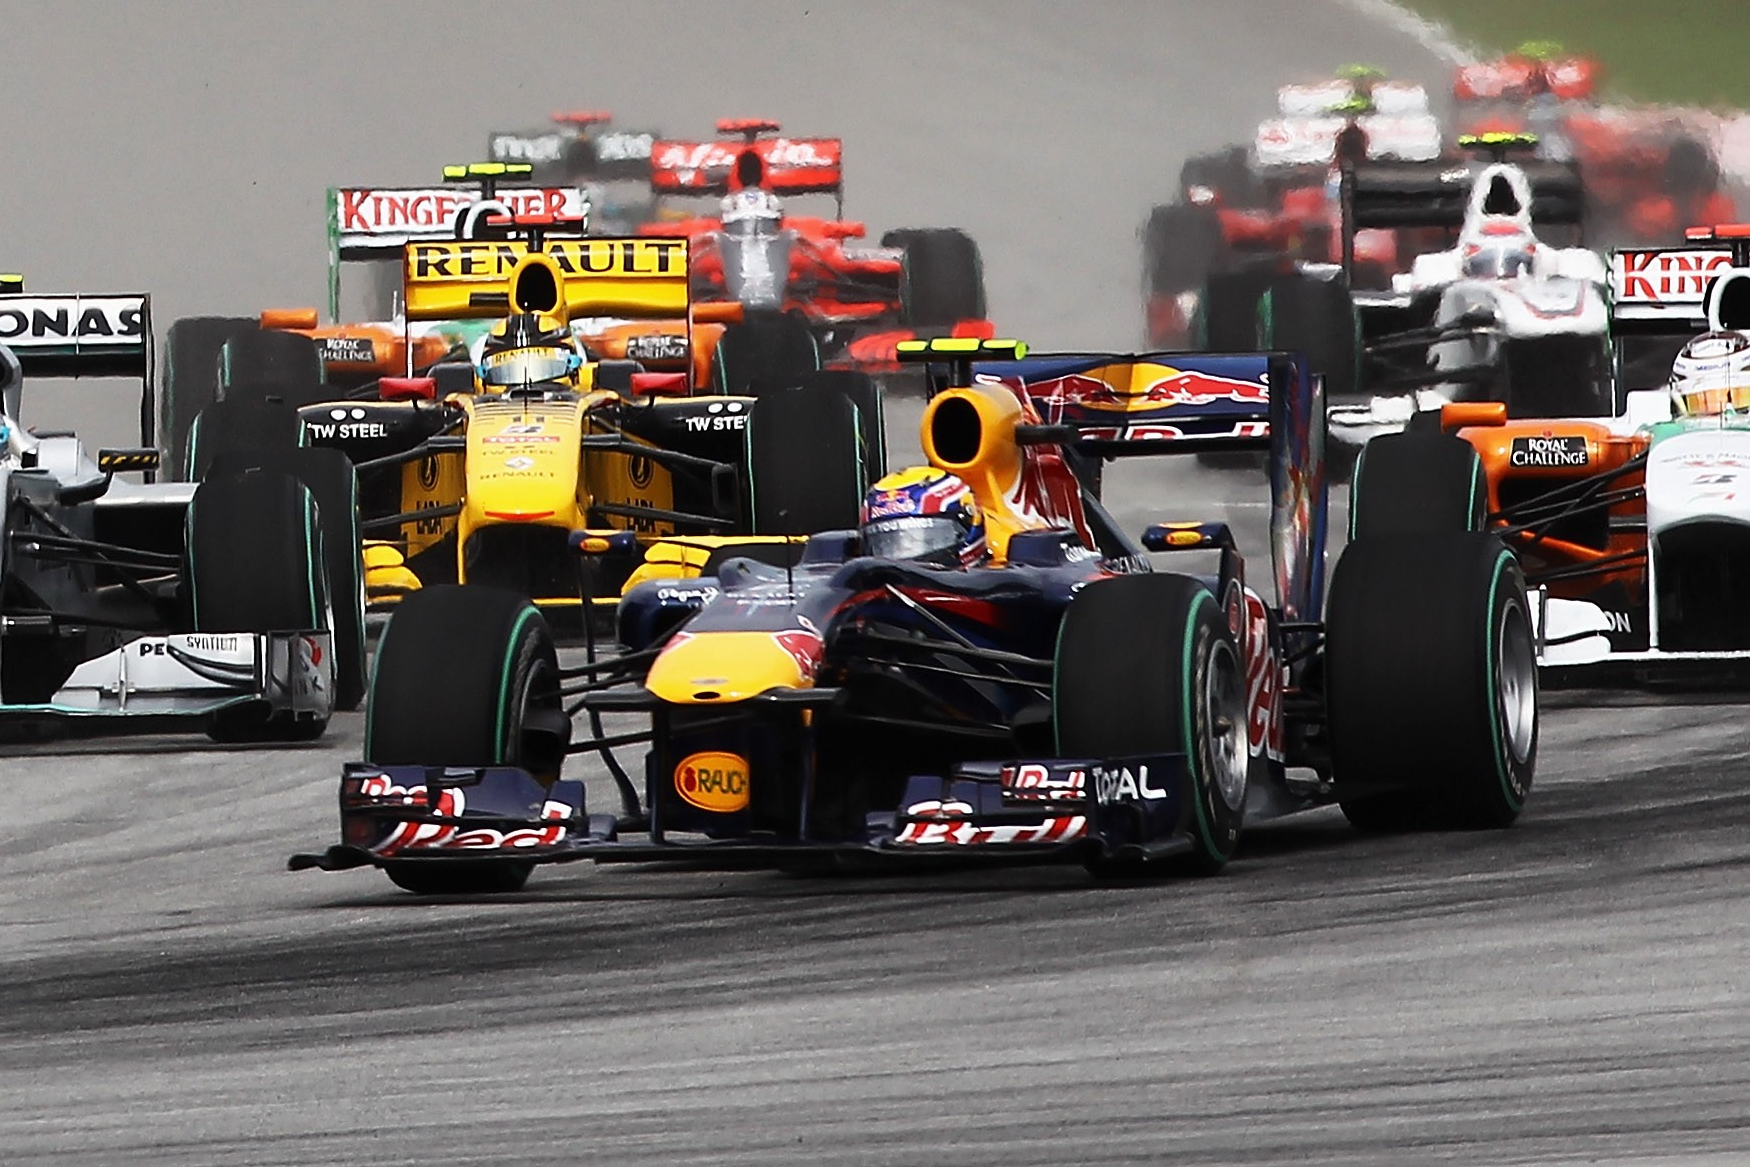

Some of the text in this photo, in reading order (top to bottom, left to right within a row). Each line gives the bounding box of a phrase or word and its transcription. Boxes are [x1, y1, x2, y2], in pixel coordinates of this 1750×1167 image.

[308, 422, 388, 439] TW STEEL
[686, 415, 748, 431] TW STE
[1528, 438, 1569, 451] ROYAL
[1512, 451, 1586, 466] CHALLENGE
[1092, 765, 1168, 806] TOTAL
